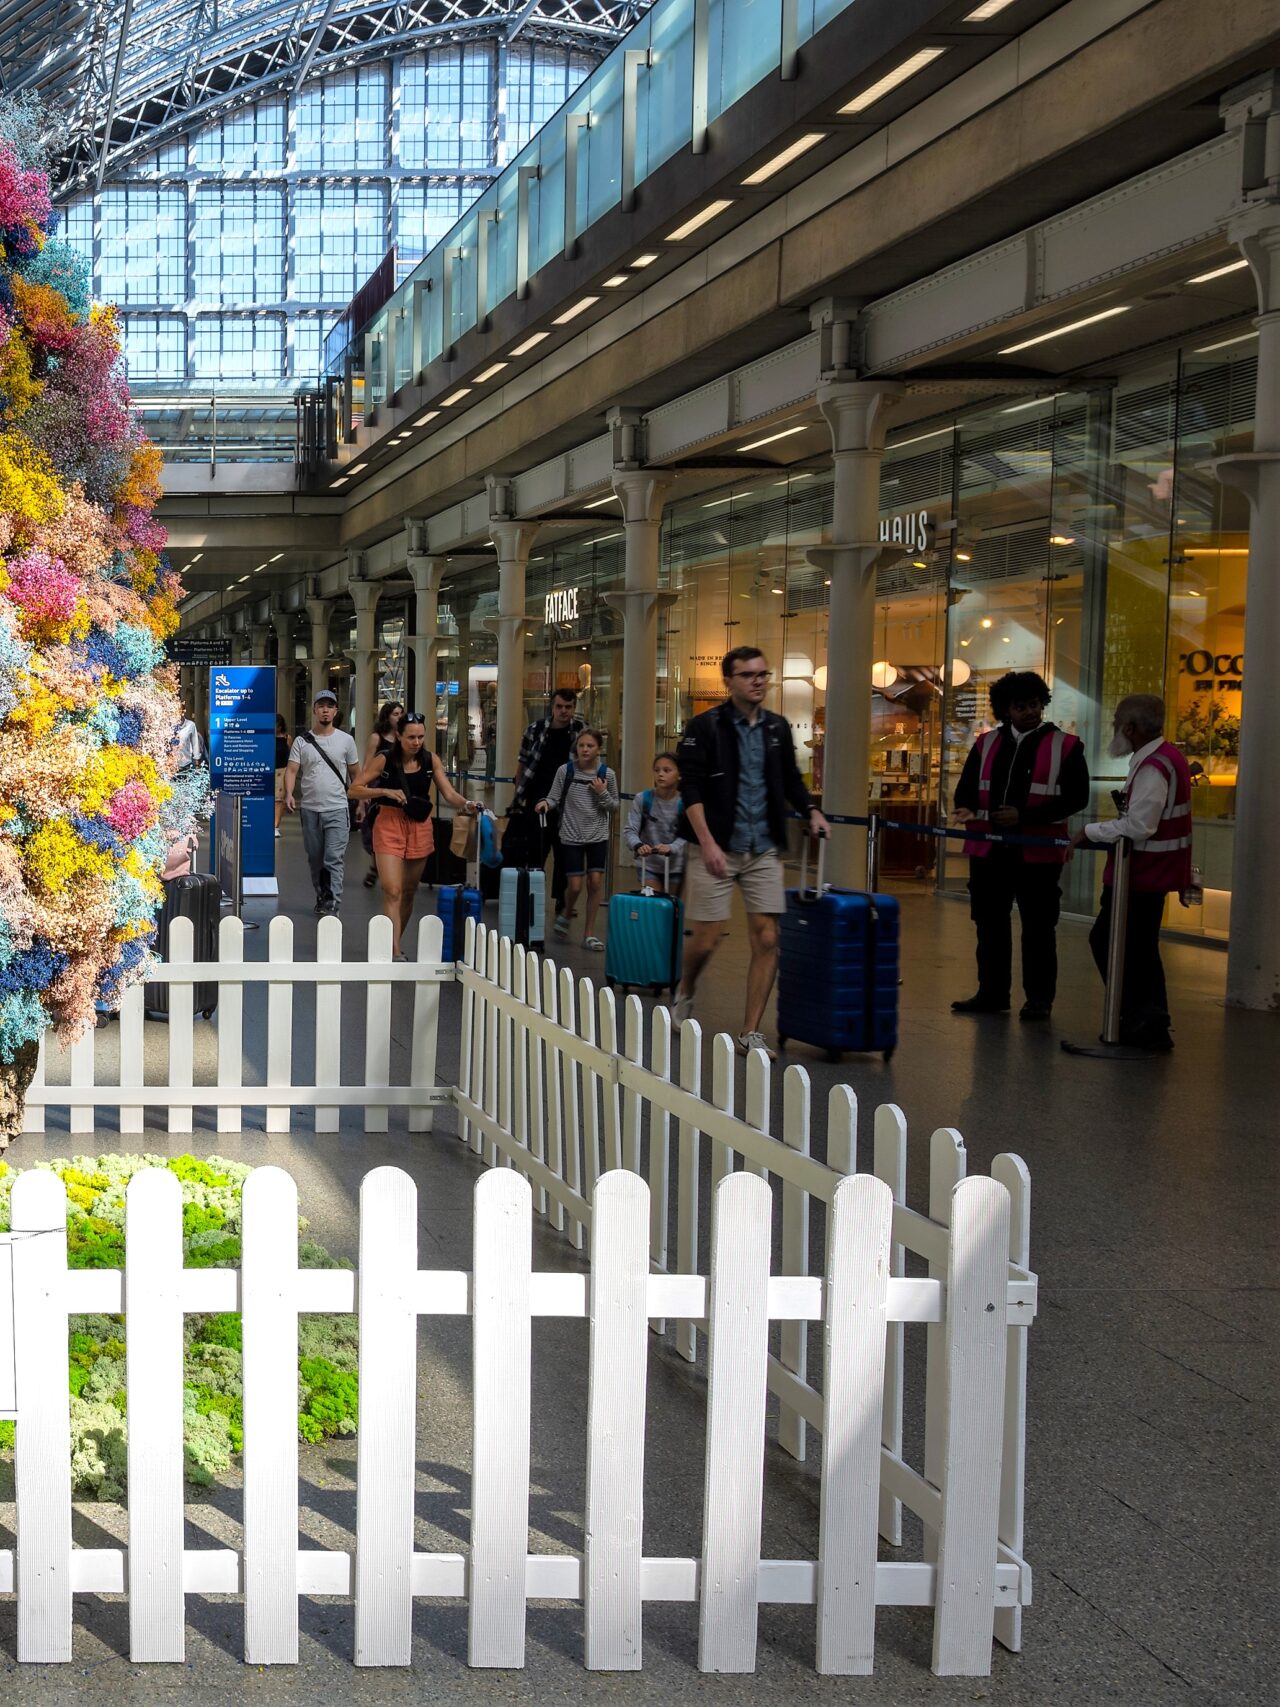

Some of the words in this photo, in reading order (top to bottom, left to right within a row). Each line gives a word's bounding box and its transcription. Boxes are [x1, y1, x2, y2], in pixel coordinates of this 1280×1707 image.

[880, 510, 928, 551] HAUS
[545, 588, 579, 624] FATFACE
[215, 718, 220, 728] 1
[216, 756, 222, 767] 0
